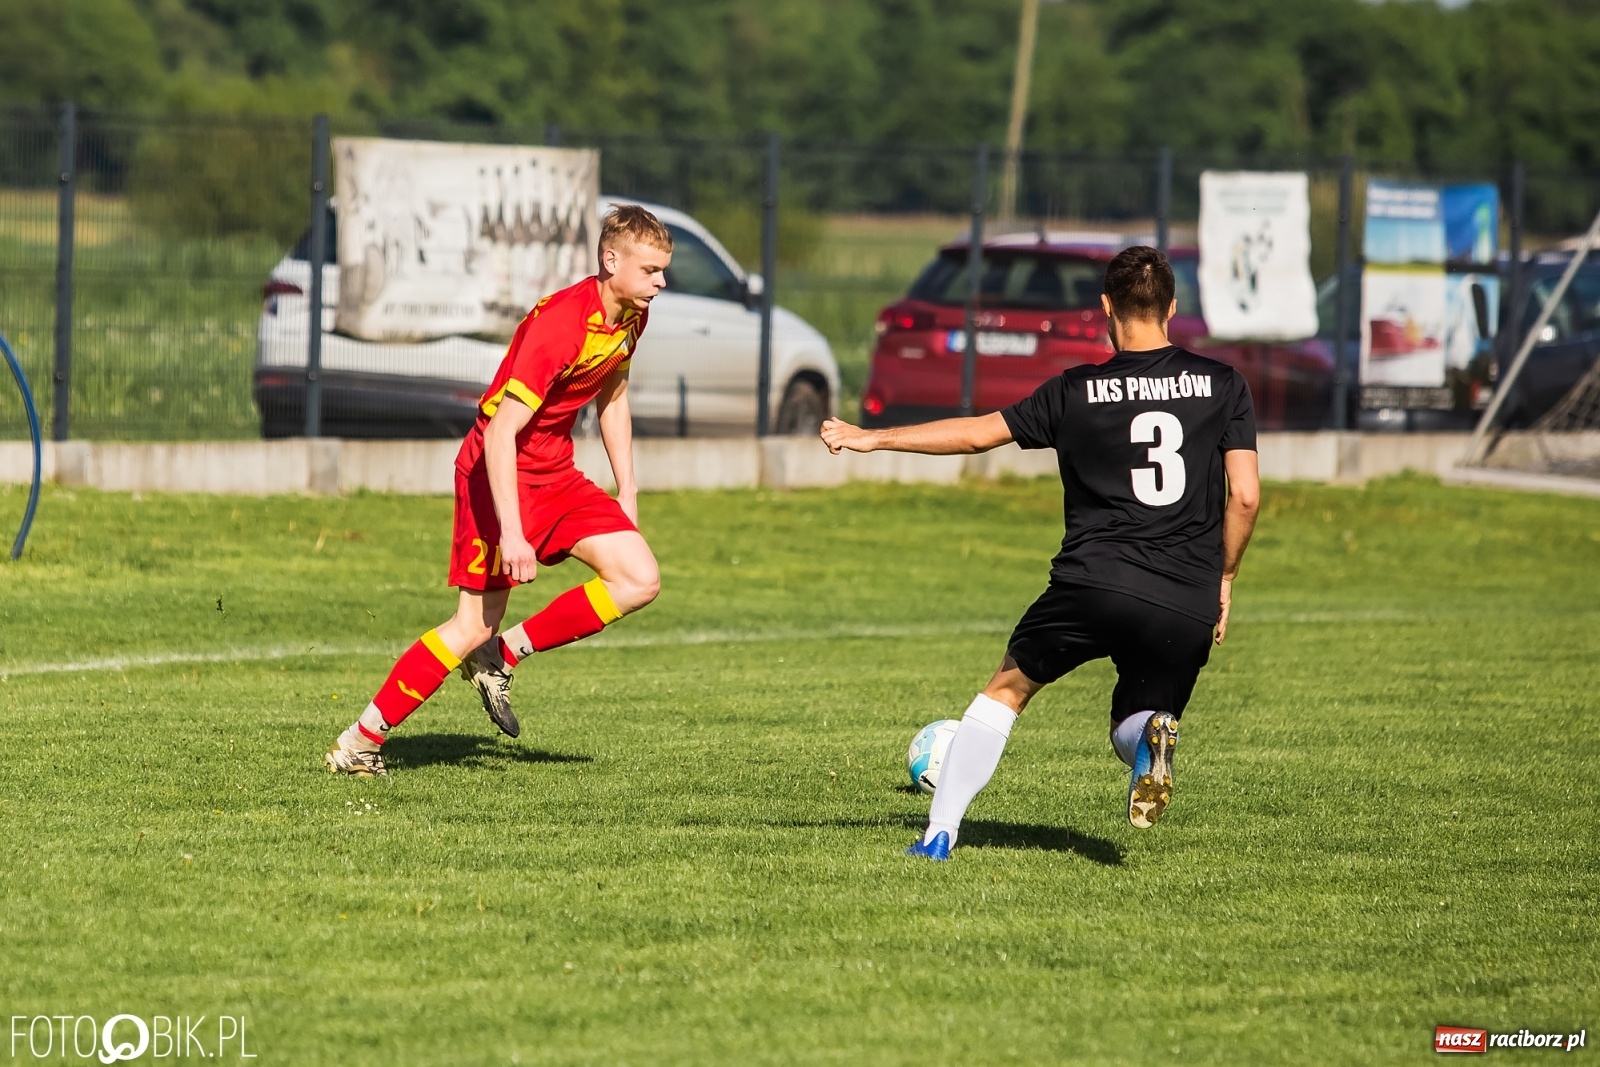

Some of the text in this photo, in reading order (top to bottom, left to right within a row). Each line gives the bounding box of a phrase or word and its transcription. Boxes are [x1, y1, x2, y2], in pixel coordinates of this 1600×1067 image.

[1086, 370, 1212, 404] LKS PAWŁÓW
[1130, 410, 1186, 507] 3
